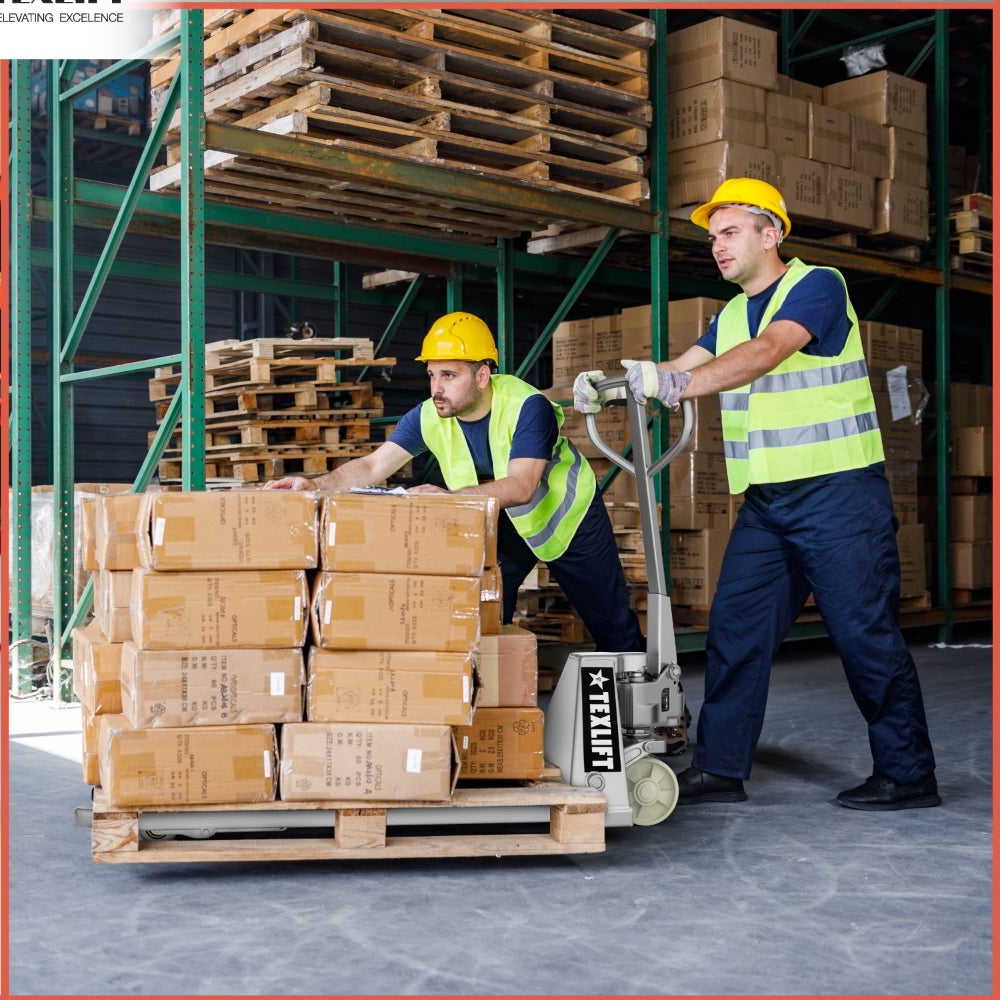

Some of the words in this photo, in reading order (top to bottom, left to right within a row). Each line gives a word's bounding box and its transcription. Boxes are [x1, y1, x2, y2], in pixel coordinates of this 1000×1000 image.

[182, 702, 188, 712] CM
[202, 701, 208, 710] KG
[589, 691, 614, 770] TEXLIFT
[327, 777, 332, 787] CM
[336, 777, 341, 786] KG
[345, 777, 351, 786] KG
